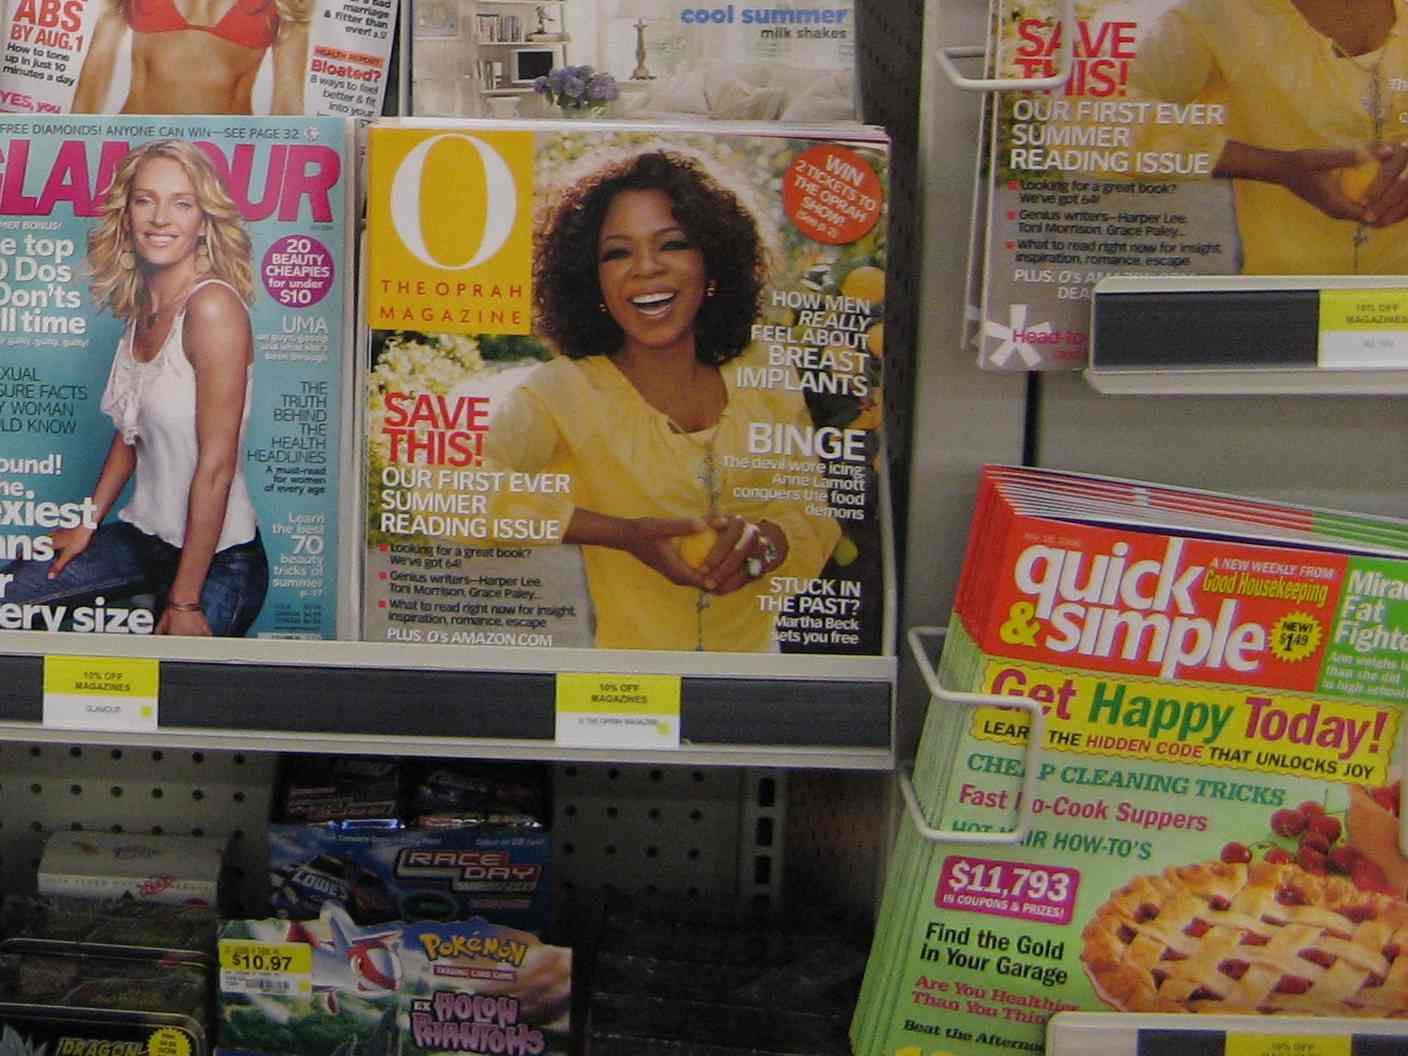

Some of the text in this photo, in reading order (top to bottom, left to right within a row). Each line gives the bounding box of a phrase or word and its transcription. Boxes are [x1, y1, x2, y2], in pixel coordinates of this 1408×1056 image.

[390, 133, 517, 271] O
[19, 232, 74, 261] top
[272, 253, 324, 265] BEAUTY
[16, 260, 71, 281] Dos
[267, 265, 330, 277] CHEAPIES
[280, 290, 312, 304] $10
[382, 280, 522, 299] THE OPRAH
[22, 310, 86, 333] time
[381, 307, 521, 325] MAGAZINE
[768, 347, 869, 373] BREAST
[737, 368, 868, 397] IMPLANTS
[383, 393, 489, 432] SAVE
[383, 431, 484, 467] THIS!
[749, 423, 865, 461] BINGE
[382, 490, 487, 514] SUMMER
[381, 514, 560, 539] READING ISSUE
[1015, 537, 1205, 619] quick
[1203, 570, 1327, 606] Good Housekeeping
[999, 602, 1037, 647] &
[1046, 601, 1265, 679] simple
[74, 682, 131, 692] MAGAZINES
[106, 672, 123, 682] OFF
[1089, 681, 1388, 761] Happy Today!
[1049, 731, 1375, 779] THE HIDDEN CODE THAT UNLOCKS JOY
[949, 867, 1069, 901] $11,793
[232, 952, 293, 975] $10.97
